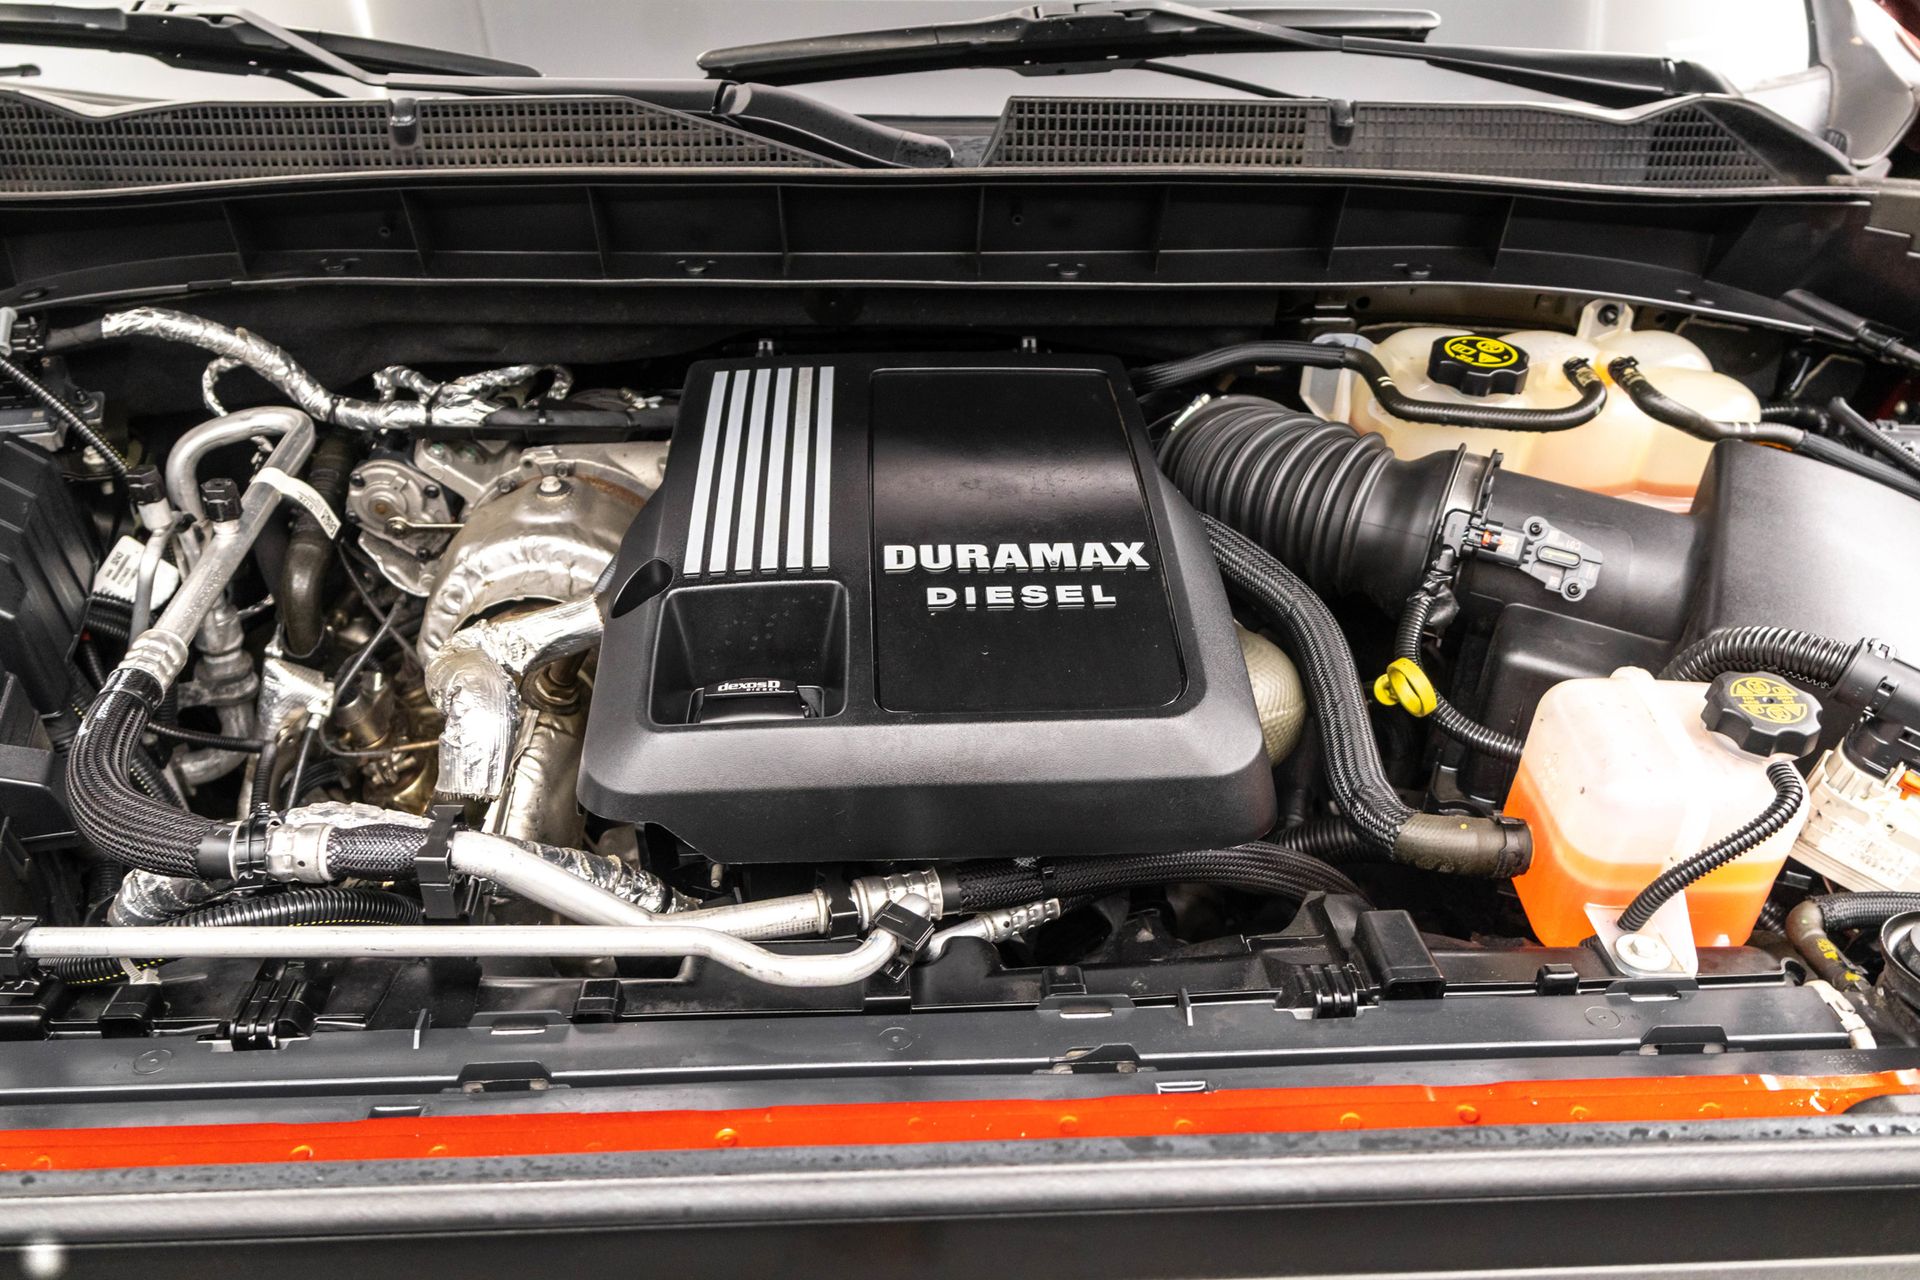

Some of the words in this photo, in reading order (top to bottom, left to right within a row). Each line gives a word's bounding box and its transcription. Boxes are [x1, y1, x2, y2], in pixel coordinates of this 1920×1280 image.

[883, 542, 1150, 571] DURAMAX
[926, 585, 1117, 608] DIESEL
[717, 680, 781, 692] dexosD
